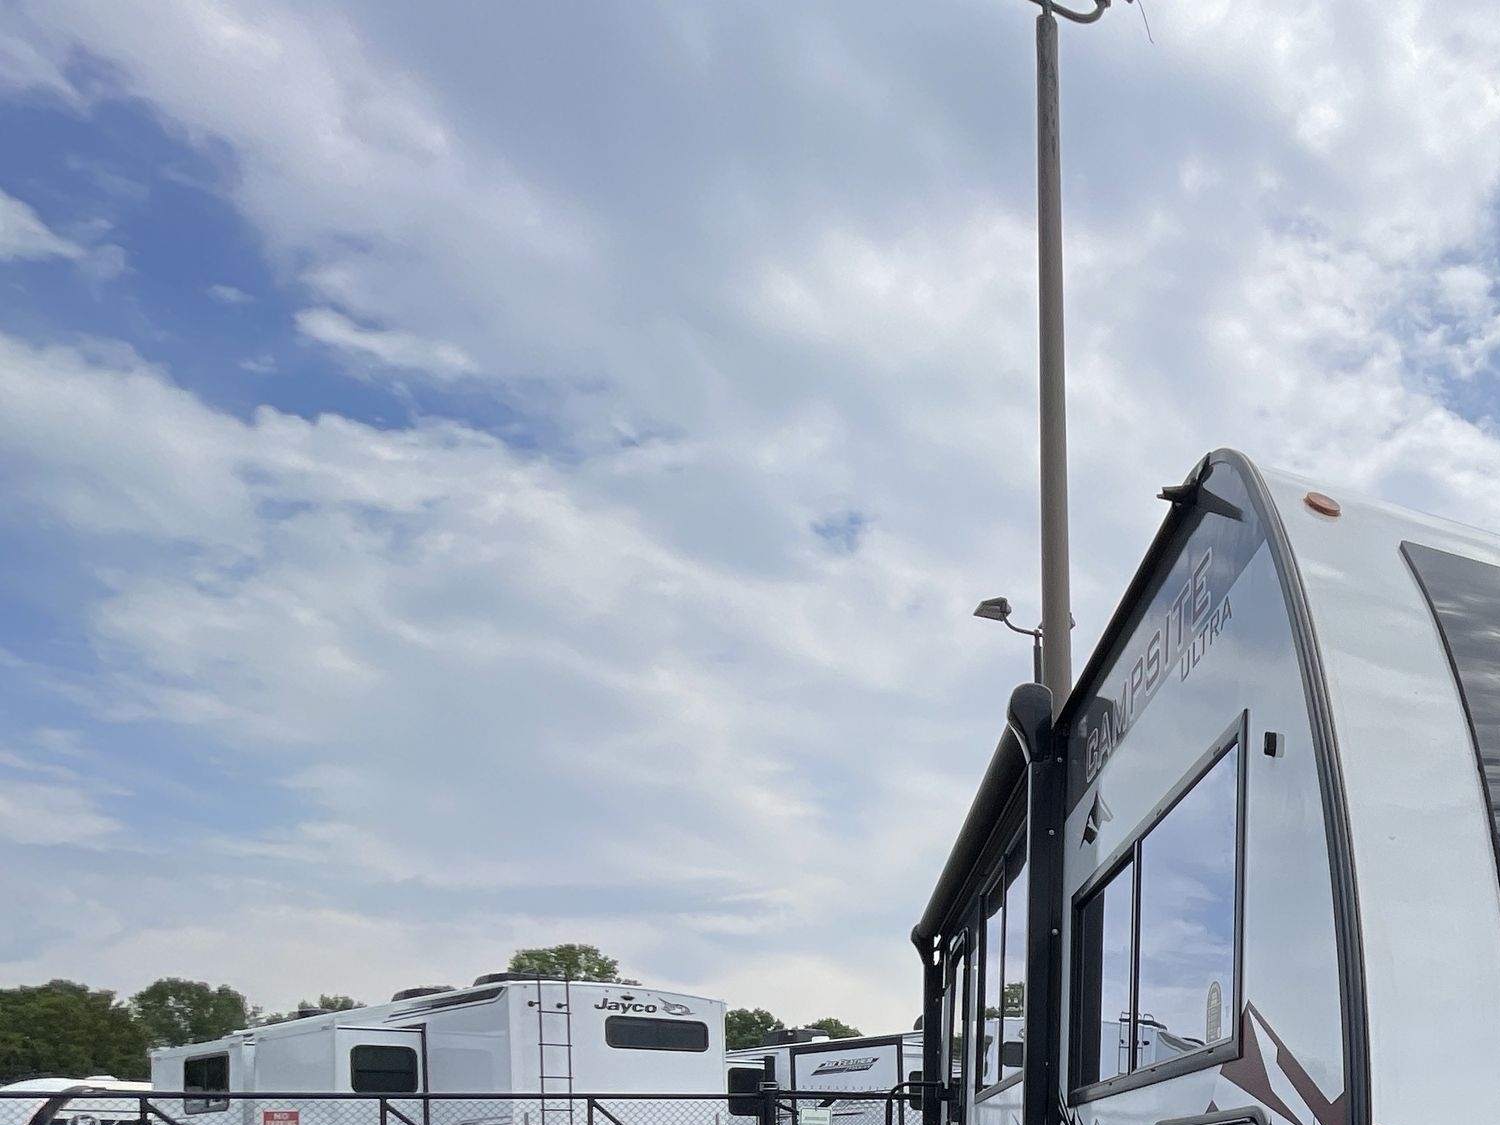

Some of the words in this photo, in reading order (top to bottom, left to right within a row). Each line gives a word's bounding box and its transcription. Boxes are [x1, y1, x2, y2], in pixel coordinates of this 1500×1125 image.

[1086, 546, 1212, 783] CAMPSITE
[1181, 595, 1233, 682] ULTRA
[594, 997, 657, 1014] Jayco
[273, 1112, 289, 1120] NO
